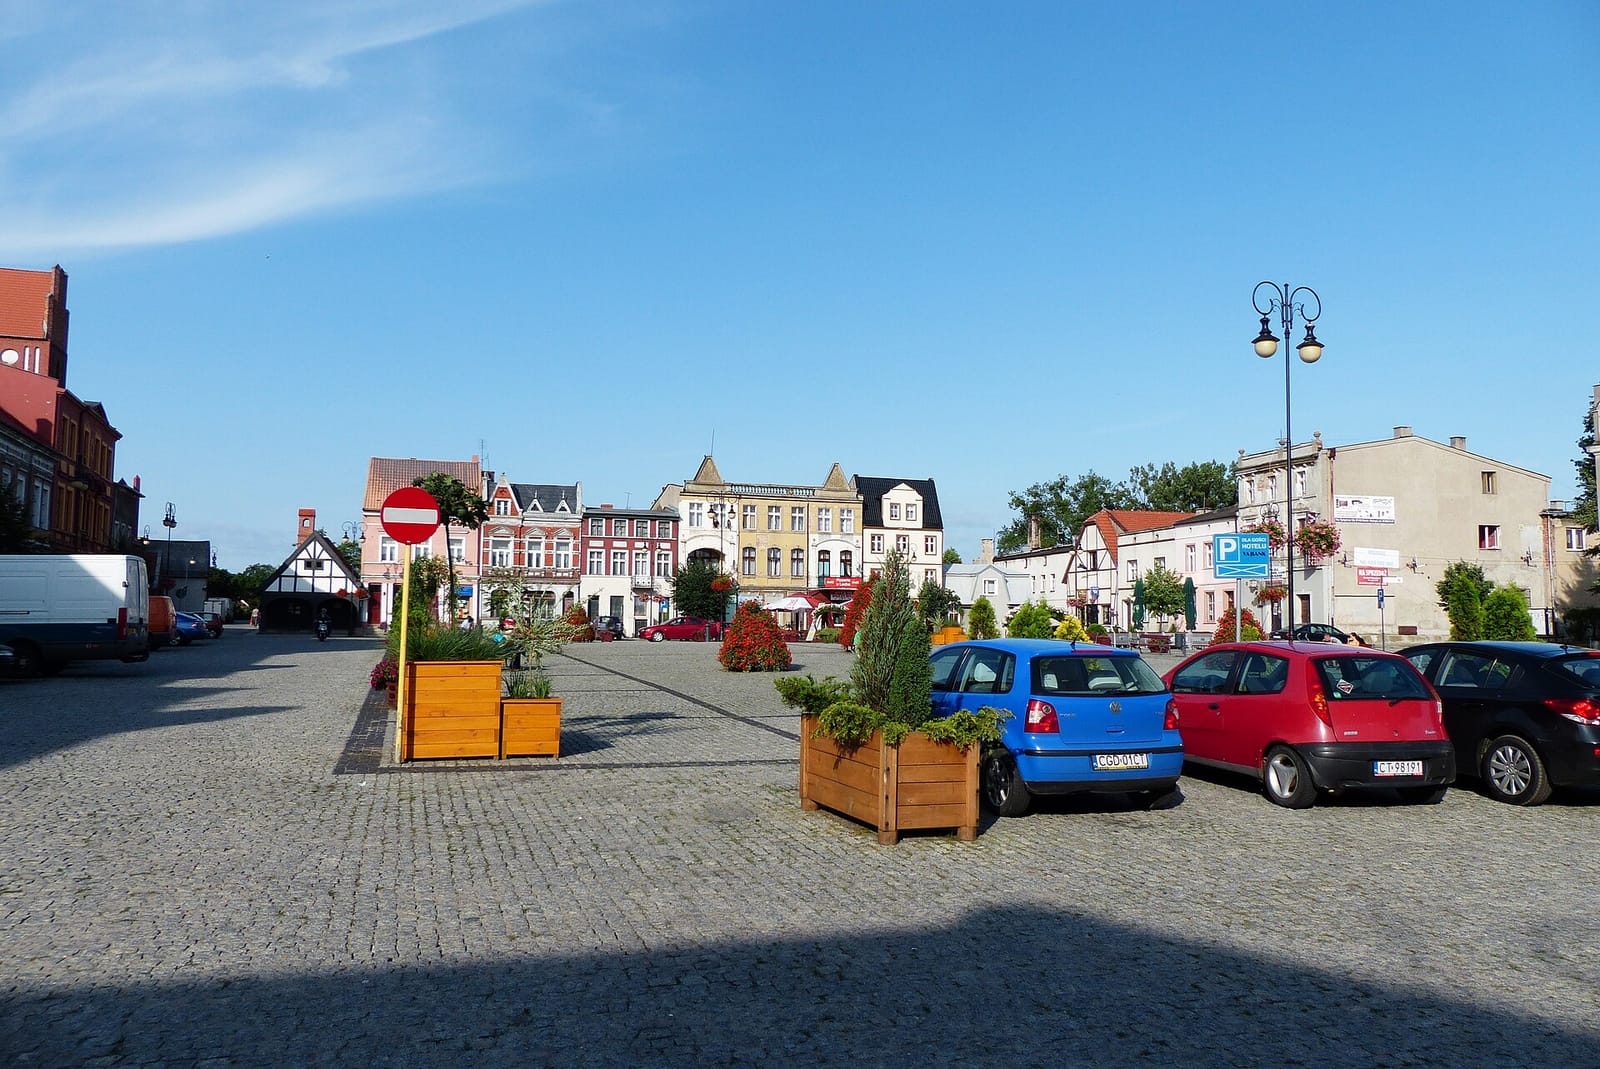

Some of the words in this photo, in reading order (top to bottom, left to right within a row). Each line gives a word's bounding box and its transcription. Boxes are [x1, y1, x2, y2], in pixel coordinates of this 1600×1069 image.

[1219, 538, 1237, 561] P
[1098, 754, 1120, 767] CGD
[1379, 762, 1393, 773] CT
[1394, 761, 1421, 773] 98191
